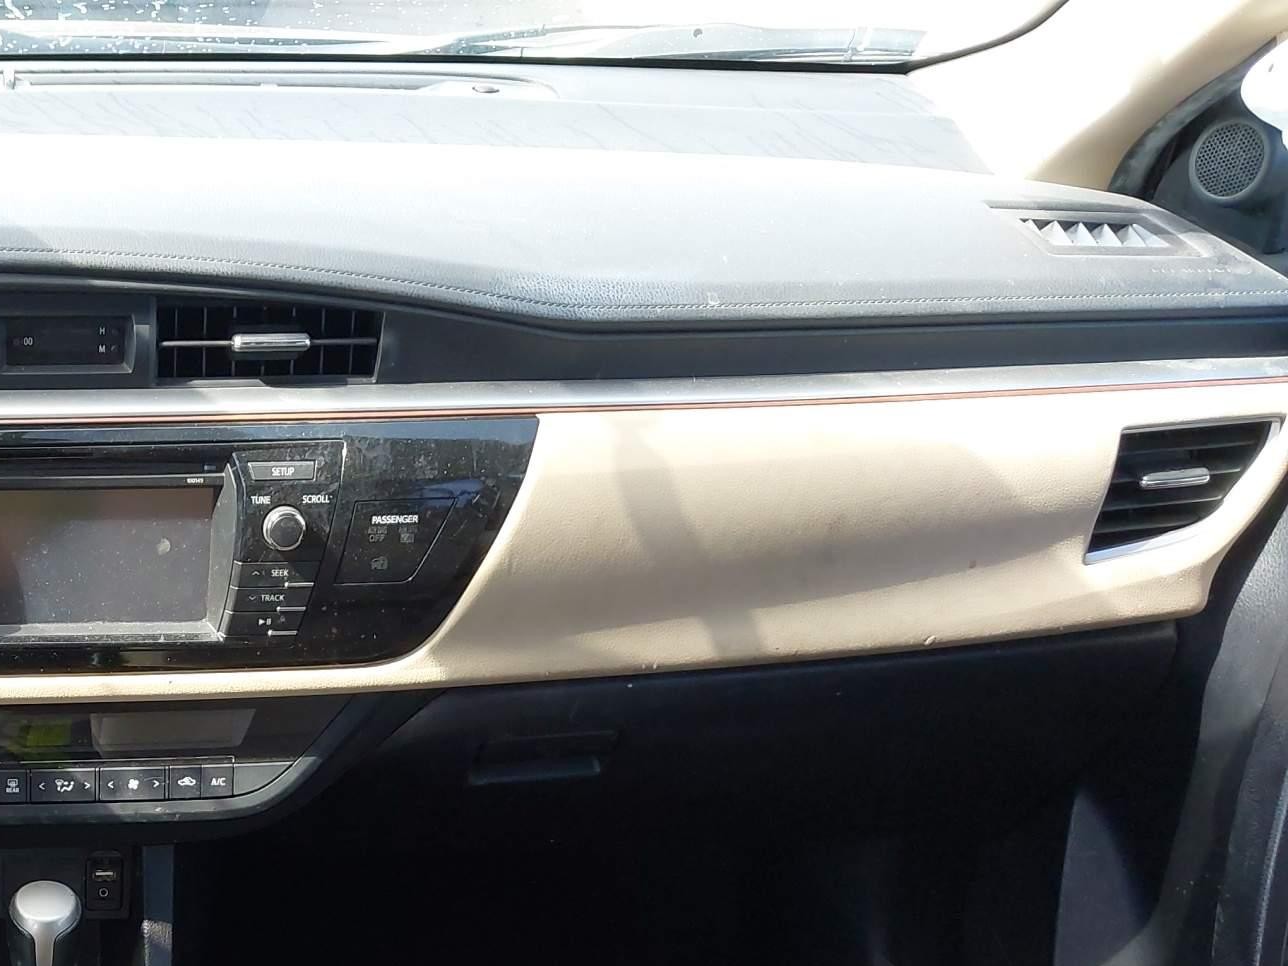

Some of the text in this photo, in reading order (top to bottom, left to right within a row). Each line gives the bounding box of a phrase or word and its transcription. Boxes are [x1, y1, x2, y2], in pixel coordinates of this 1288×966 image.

[99, 327, 106, 335] H
[98, 344, 106, 353] M
[271, 466, 295, 476] SETUP
[250, 495, 271, 504] TUNE
[302, 494, 331, 504] SCROLL
[371, 514, 419, 525] PASSENGER
[369, 534, 386, 543] OFF
[271, 569, 289, 577] SEEK
[260, 594, 286, 602] TRACK
[210, 775, 227, 787] A/C
